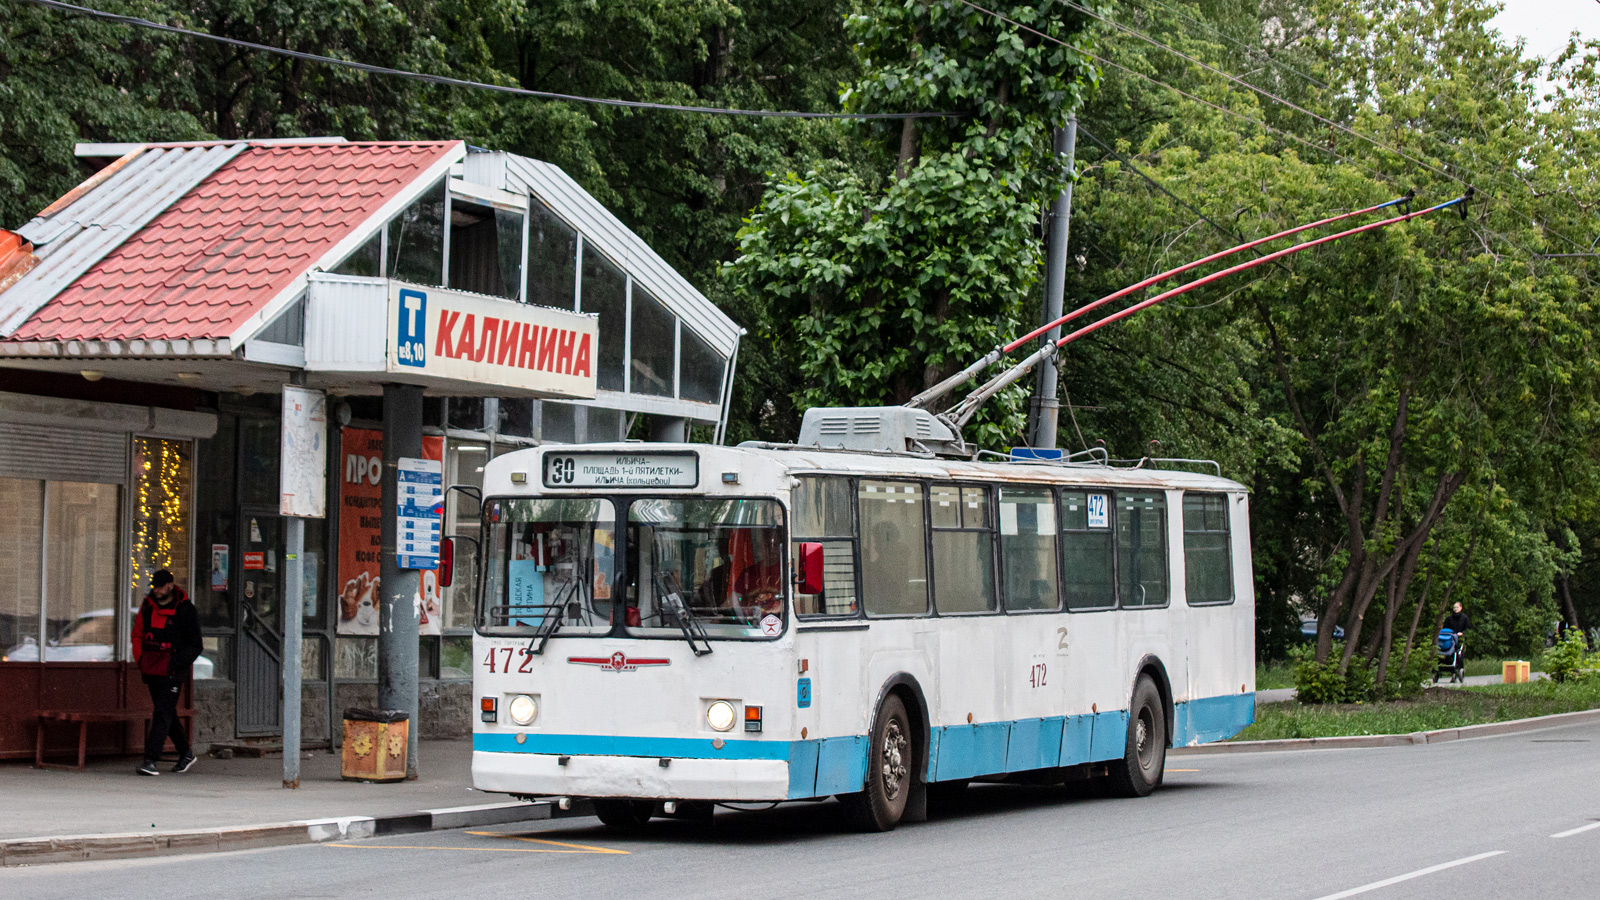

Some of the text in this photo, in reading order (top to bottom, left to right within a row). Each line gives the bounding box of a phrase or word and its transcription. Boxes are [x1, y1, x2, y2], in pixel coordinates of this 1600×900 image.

[404, 296, 422, 336] Т
[435, 309, 590, 378] КАЛИНИНА
[552, 458, 575, 484] 30
[583, 466, 620, 474] ПЛОЩАДЬ
[1089, 496, 1104, 516] 472
[483, 648, 533, 673] 472
[1030, 663, 1047, 688] 472
